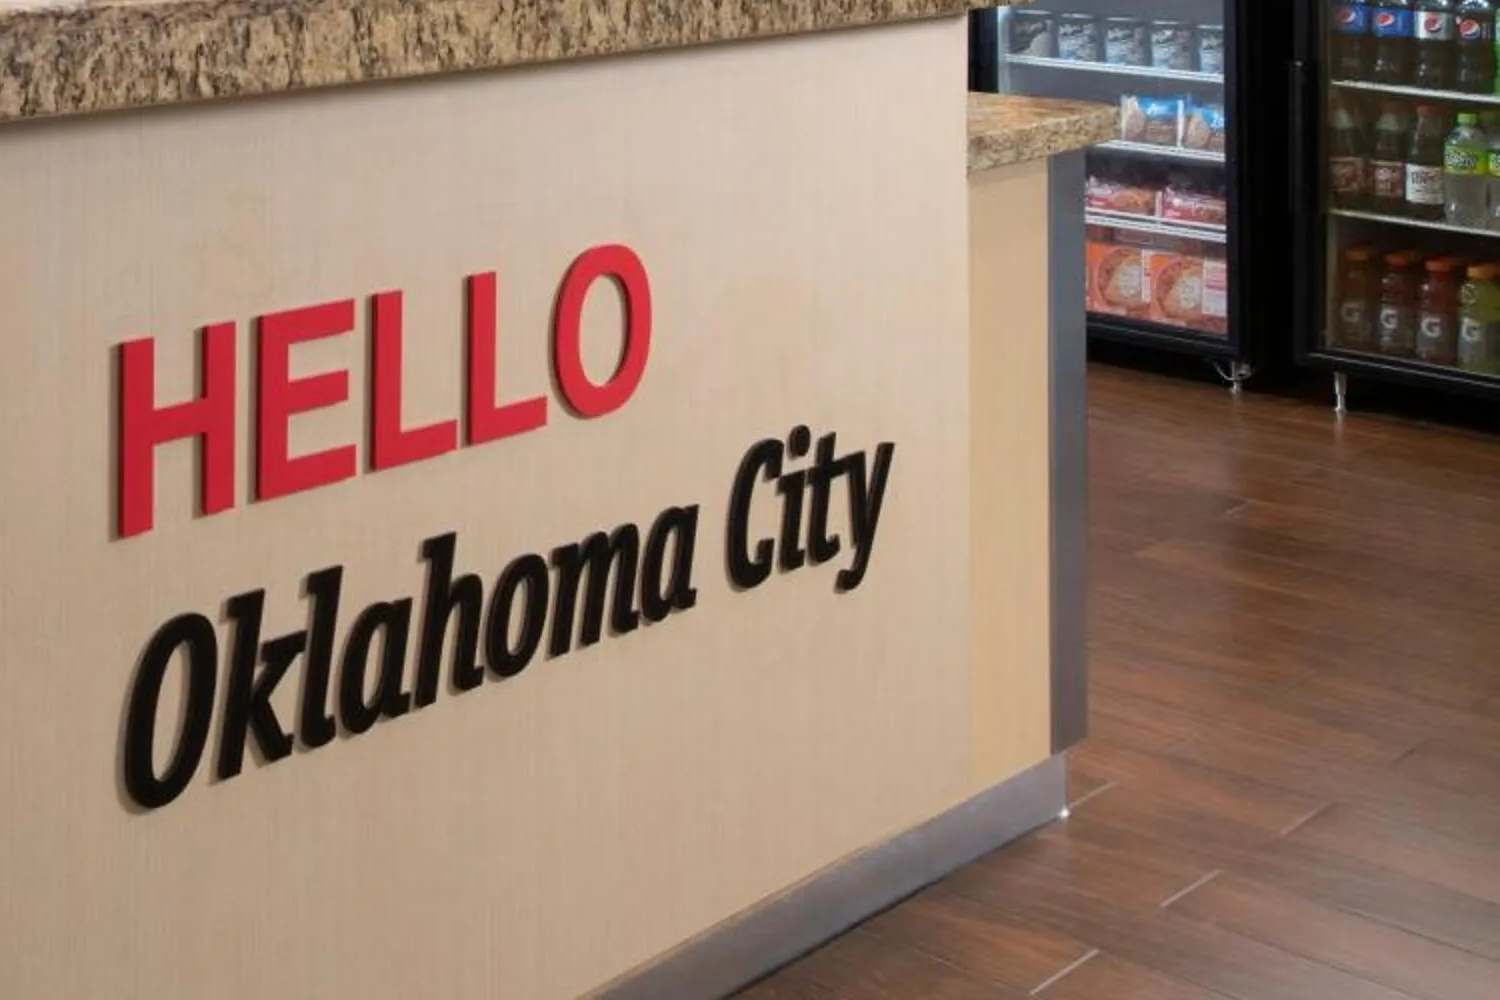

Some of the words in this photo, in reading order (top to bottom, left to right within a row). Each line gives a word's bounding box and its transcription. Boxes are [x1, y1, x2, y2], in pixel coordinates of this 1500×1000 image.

[117, 243, 652, 540] HELLO
[122, 503, 700, 810] Oklahoma
[727, 424, 895, 592] City
